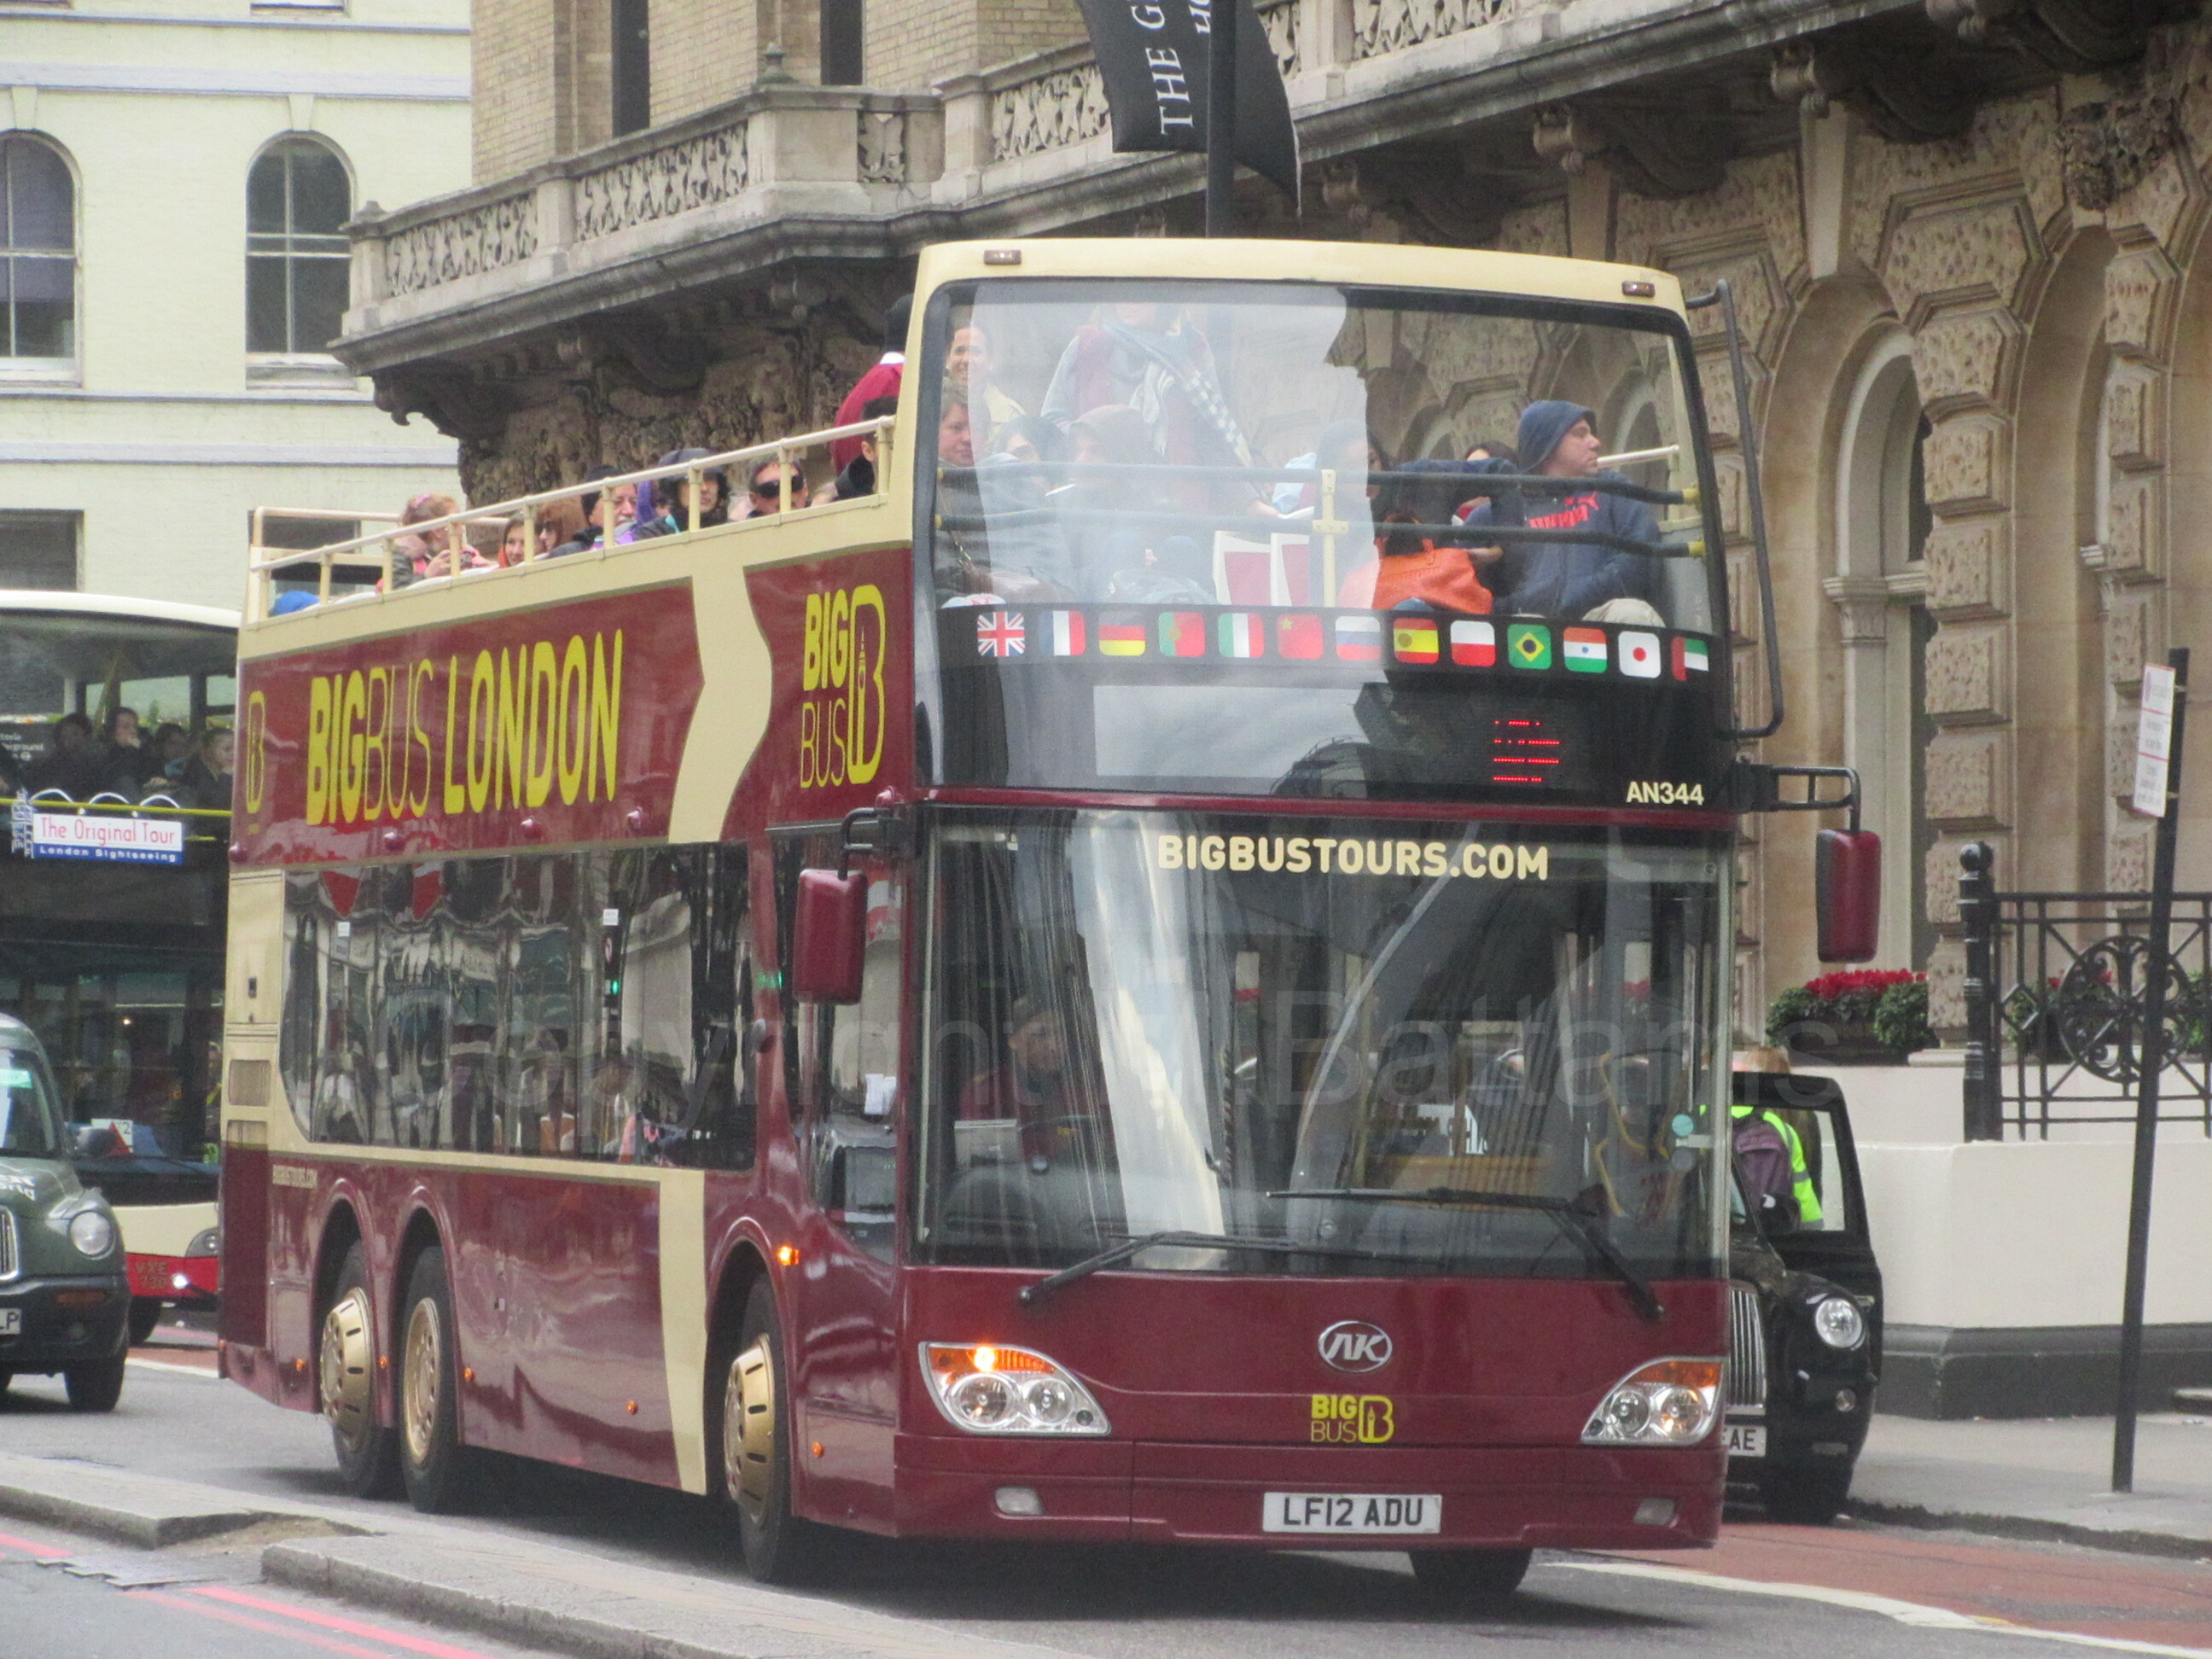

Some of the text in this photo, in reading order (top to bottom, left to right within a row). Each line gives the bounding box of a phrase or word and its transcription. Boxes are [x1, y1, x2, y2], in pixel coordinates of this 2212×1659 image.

[1144, 47, 1194, 136] THE
[803, 588, 849, 691] BIG
[443, 628, 623, 815] LONDON
[800, 697, 847, 789] BUS
[1625, 781, 1704, 806] AN344
[41, 816, 175, 847] The Original Tour
[39, 845, 177, 864] London Sightseeing
[1156, 834, 1549, 882] BIGBUSTOURS.COM
[1311, 1394, 1358, 1419] BIG
[1310, 1420, 1357, 1442] BUS
[1722, 1428, 1757, 1451] AE
[1283, 1498, 1423, 1527] LF12 ADU
